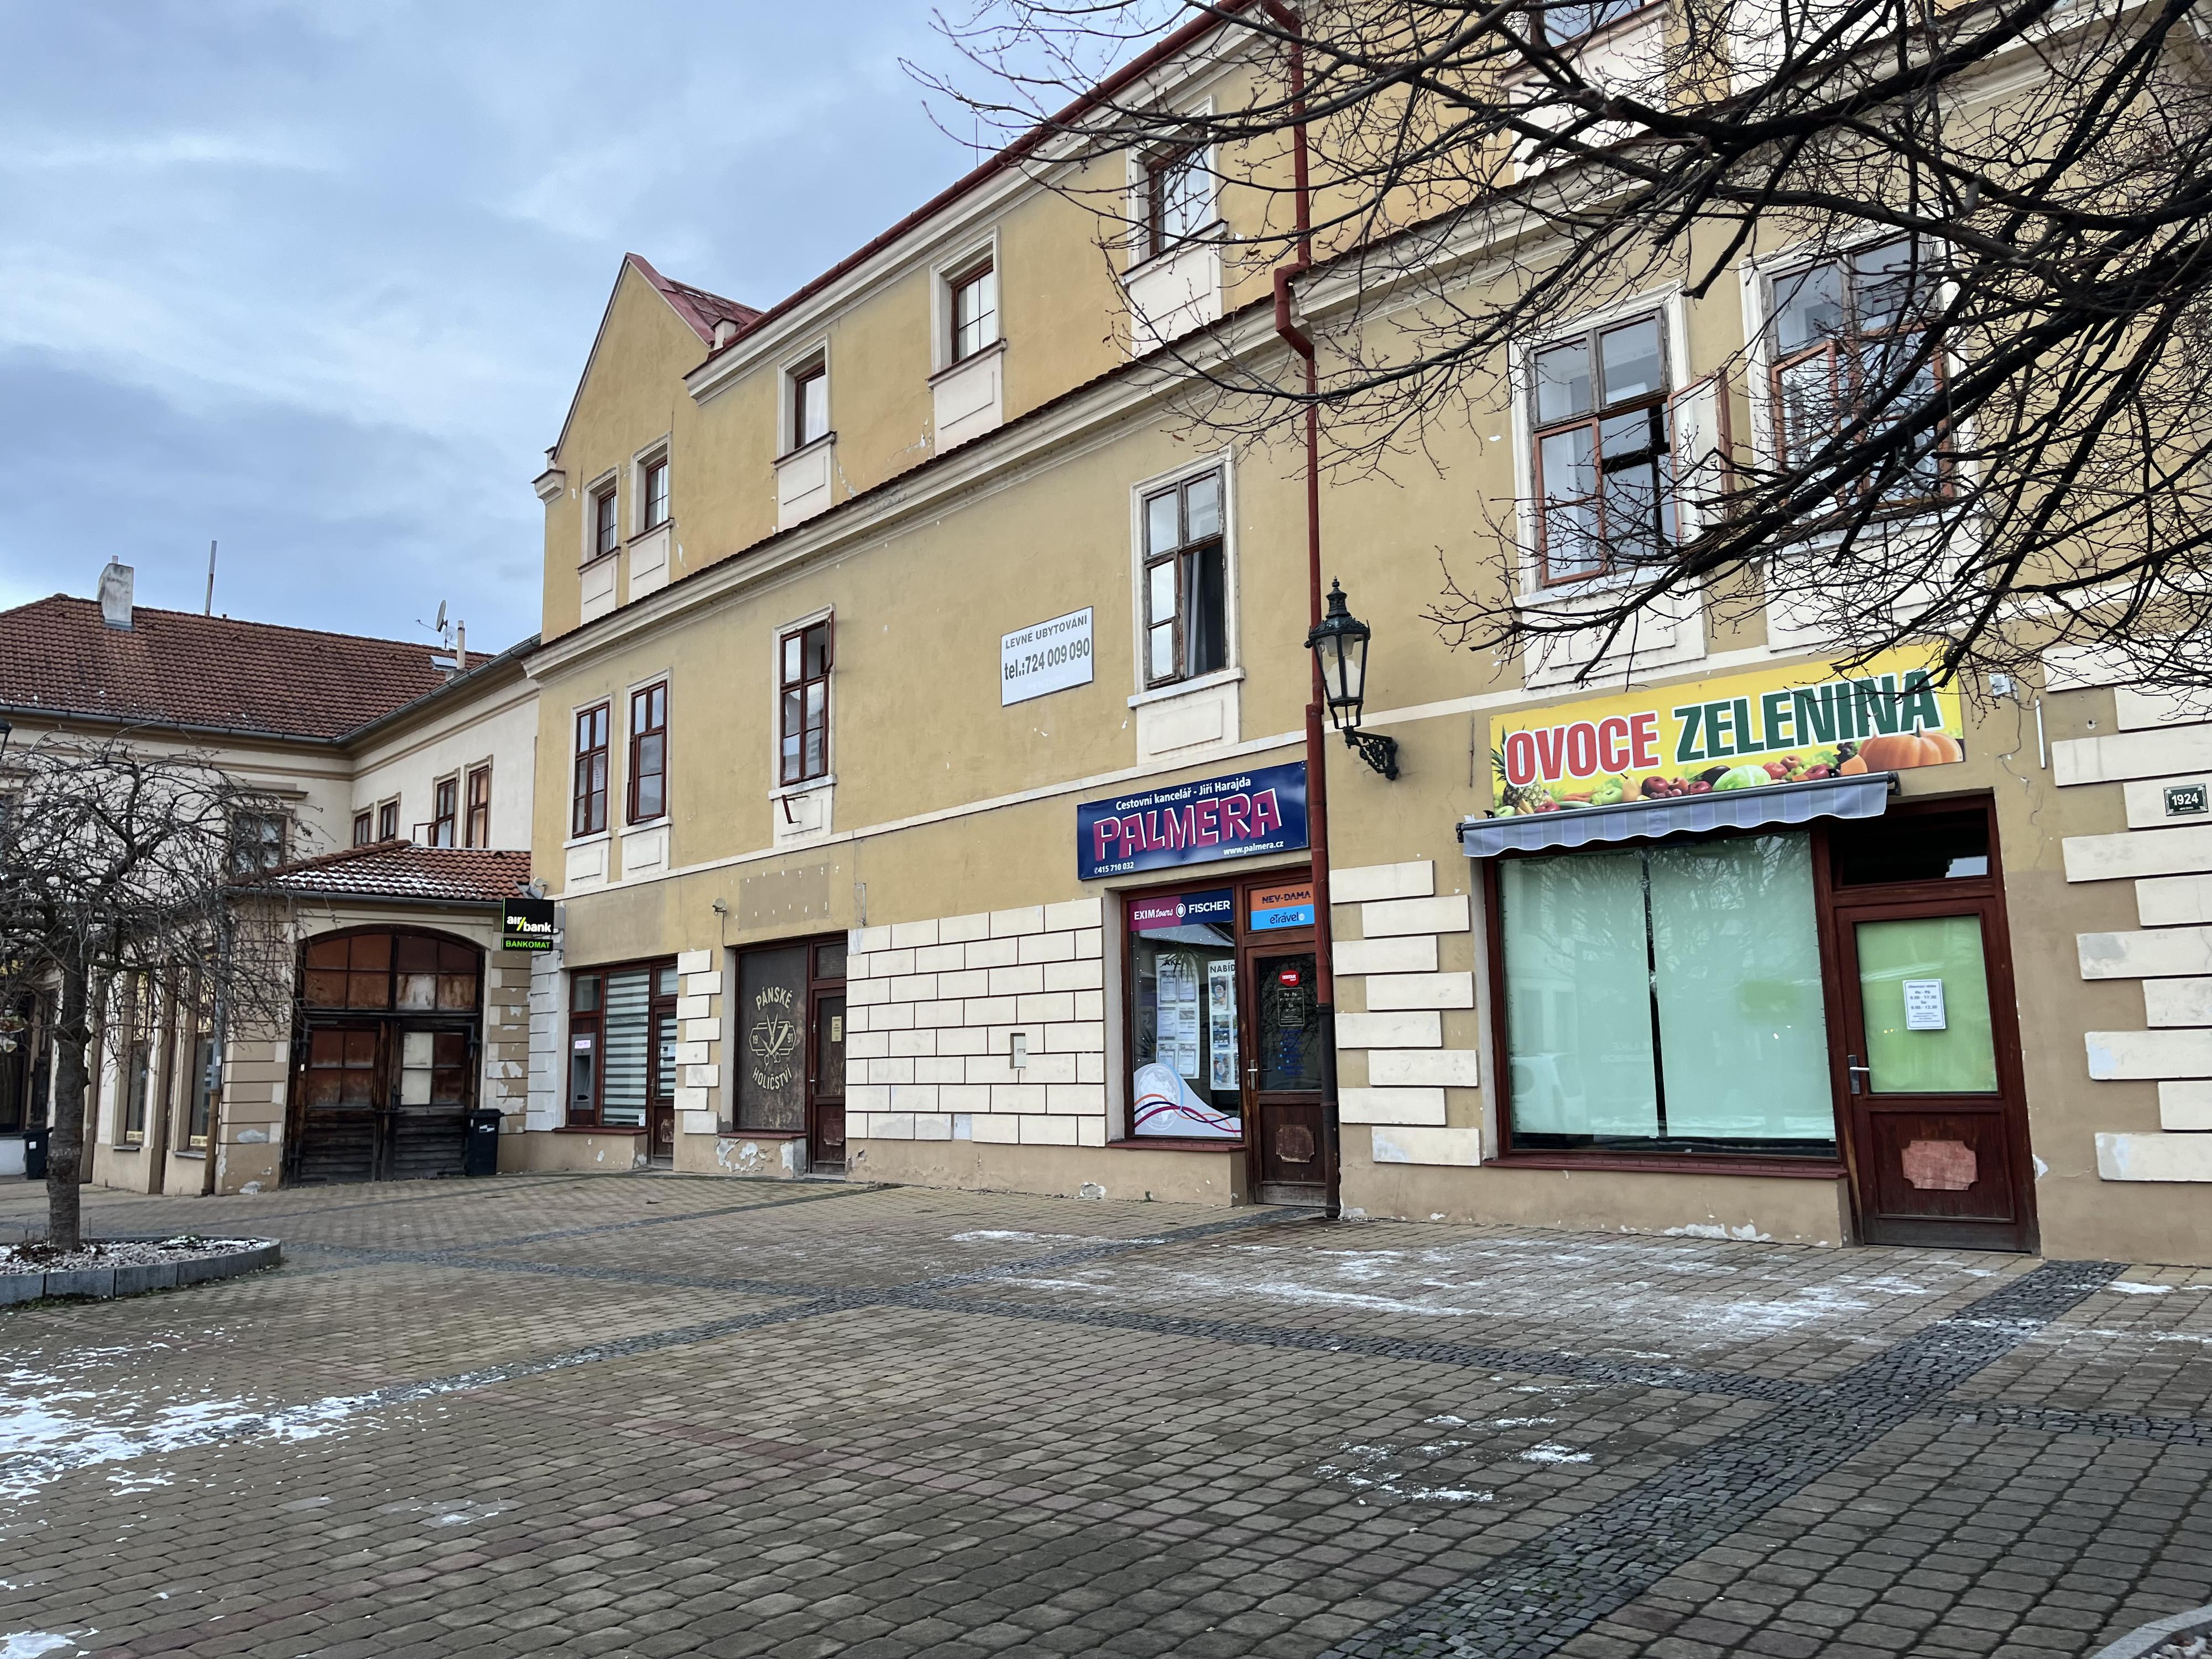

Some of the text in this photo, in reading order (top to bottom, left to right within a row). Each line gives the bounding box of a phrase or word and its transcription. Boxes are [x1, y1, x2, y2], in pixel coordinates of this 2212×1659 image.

[1005, 612, 1087, 649] LEVNÉ UBYTOVÁNÍ
[1047, 645, 1067, 667] 009
[1070, 638, 1090, 660] 090
[1505, 669, 1942, 786] OVOCE ZELENINA
[1115, 795, 1152, 811] Cestovní
[1154, 787, 1191, 804] kancelář
[1199, 783, 1212, 796] Jiří
[1214, 776, 1251, 792] Harajda
[2172, 792, 2199, 806] 1924
[1093, 787, 1282, 861] PALMERA
[1223, 841, 1284, 855] www.palmera.cz
[1098, 865, 1109, 874] 415
[1110, 863, 1121, 872] 710
[1189, 900, 1230, 914] FISCHER
[1262, 891, 1311, 904] NEV-DAMA
[505, 940, 551, 948] BANKOMAT
[755, 986, 792, 1011] PÁNSKÉ
[753, 1032, 794, 1044] 19 91
[752, 1063, 792, 1090] HOLIČSTVÍ
